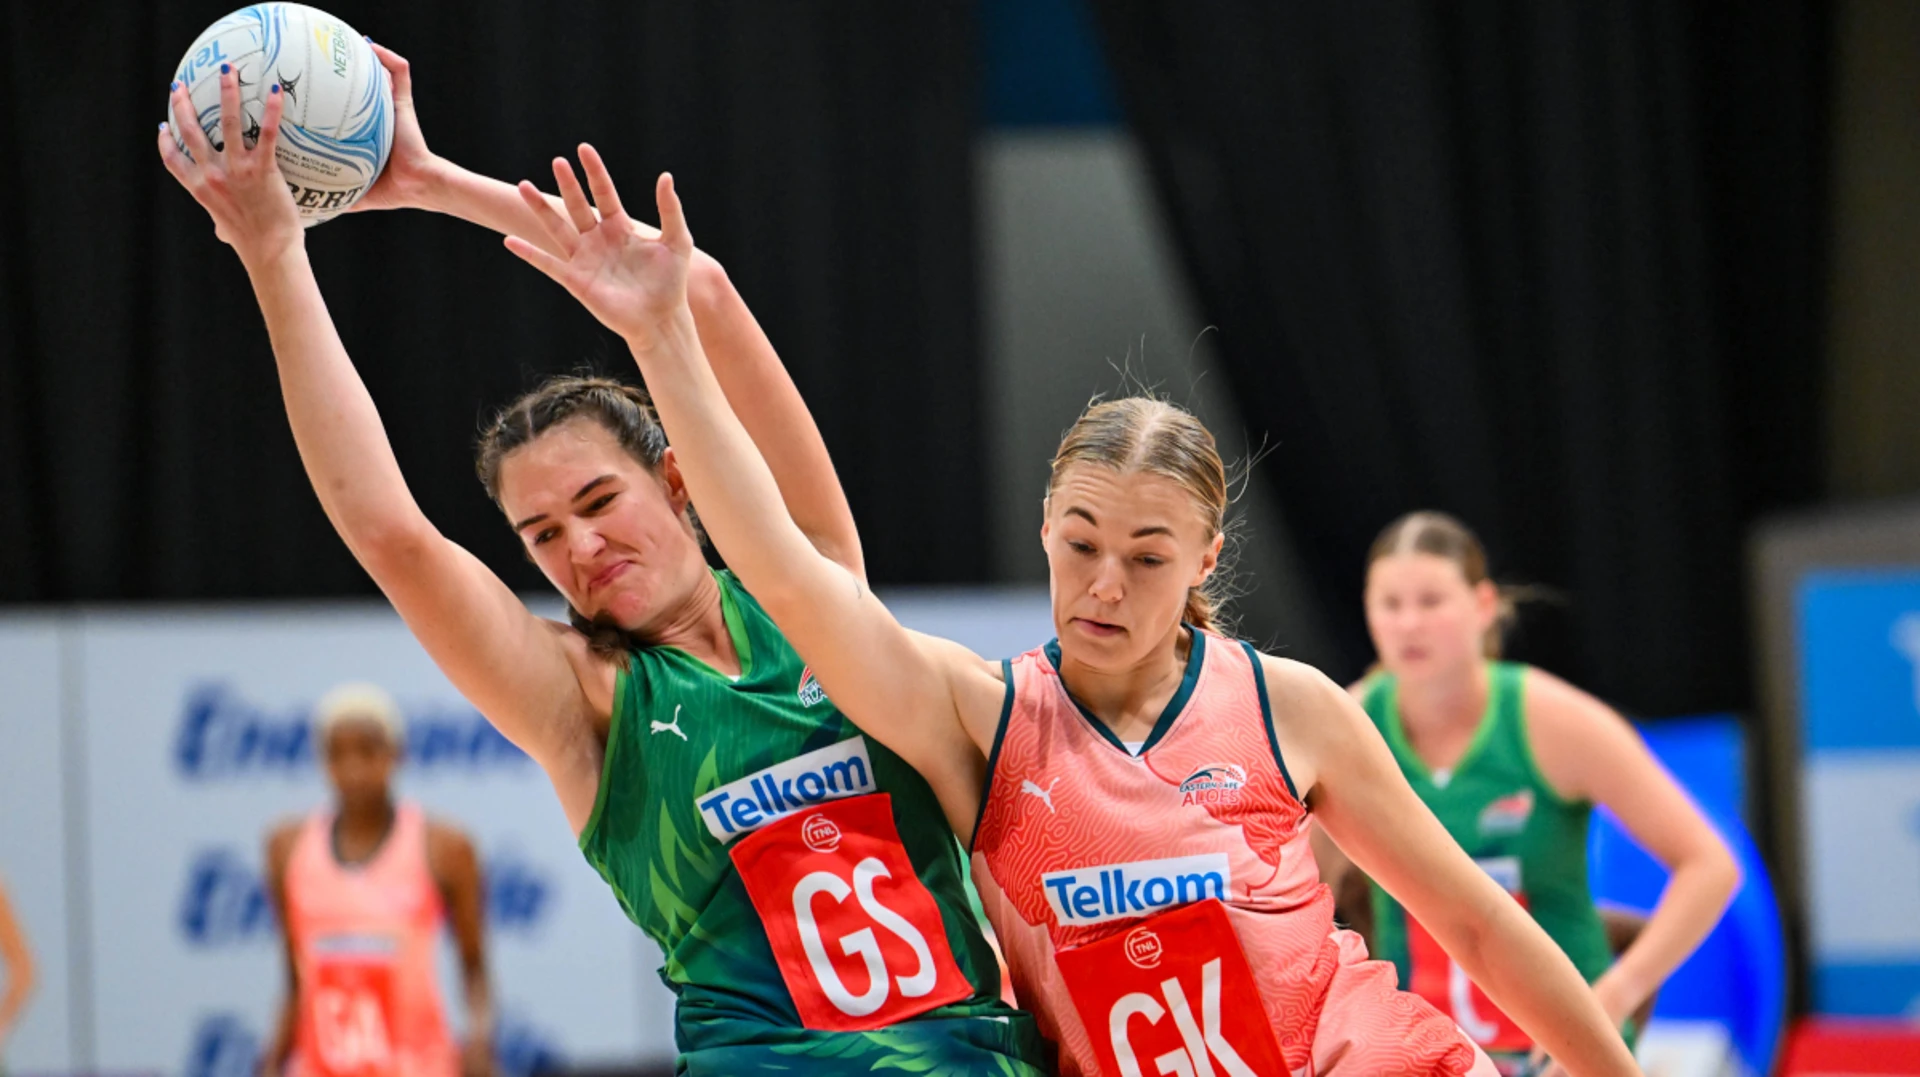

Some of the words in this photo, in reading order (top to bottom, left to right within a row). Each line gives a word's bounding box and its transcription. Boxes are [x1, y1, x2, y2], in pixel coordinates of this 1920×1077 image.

[700, 755, 869, 833] Telkom
[1181, 789, 1239, 807] ALOES
[812, 825, 836, 840] TNL
[1045, 868, 1225, 920] Telkom
[791, 856, 937, 1017] GS
[1135, 940, 1157, 955] TNL
[1109, 957, 1259, 1077] GK
